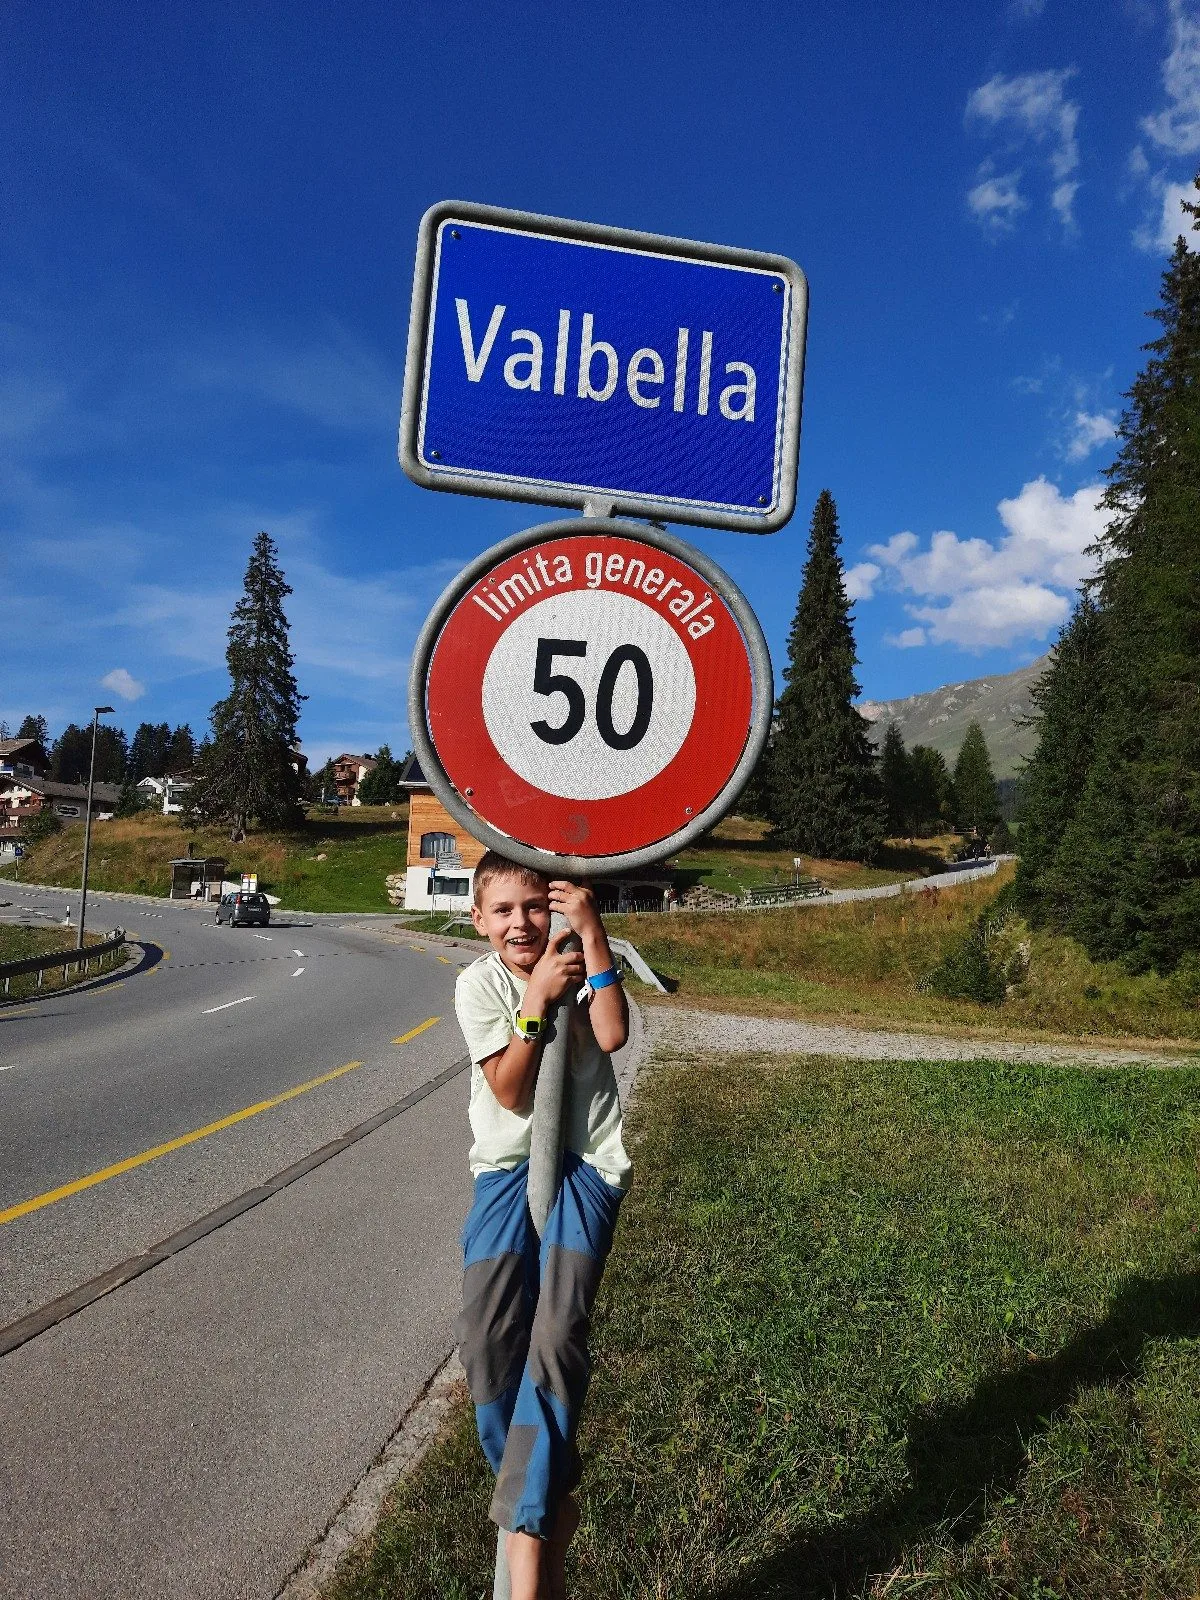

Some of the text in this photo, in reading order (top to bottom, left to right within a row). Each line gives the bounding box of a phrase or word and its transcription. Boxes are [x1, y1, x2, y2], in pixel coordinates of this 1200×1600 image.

[455, 298, 757, 422] Valbella
[472, 552, 715, 640] limita generala
[530, 637, 654, 751] 50
